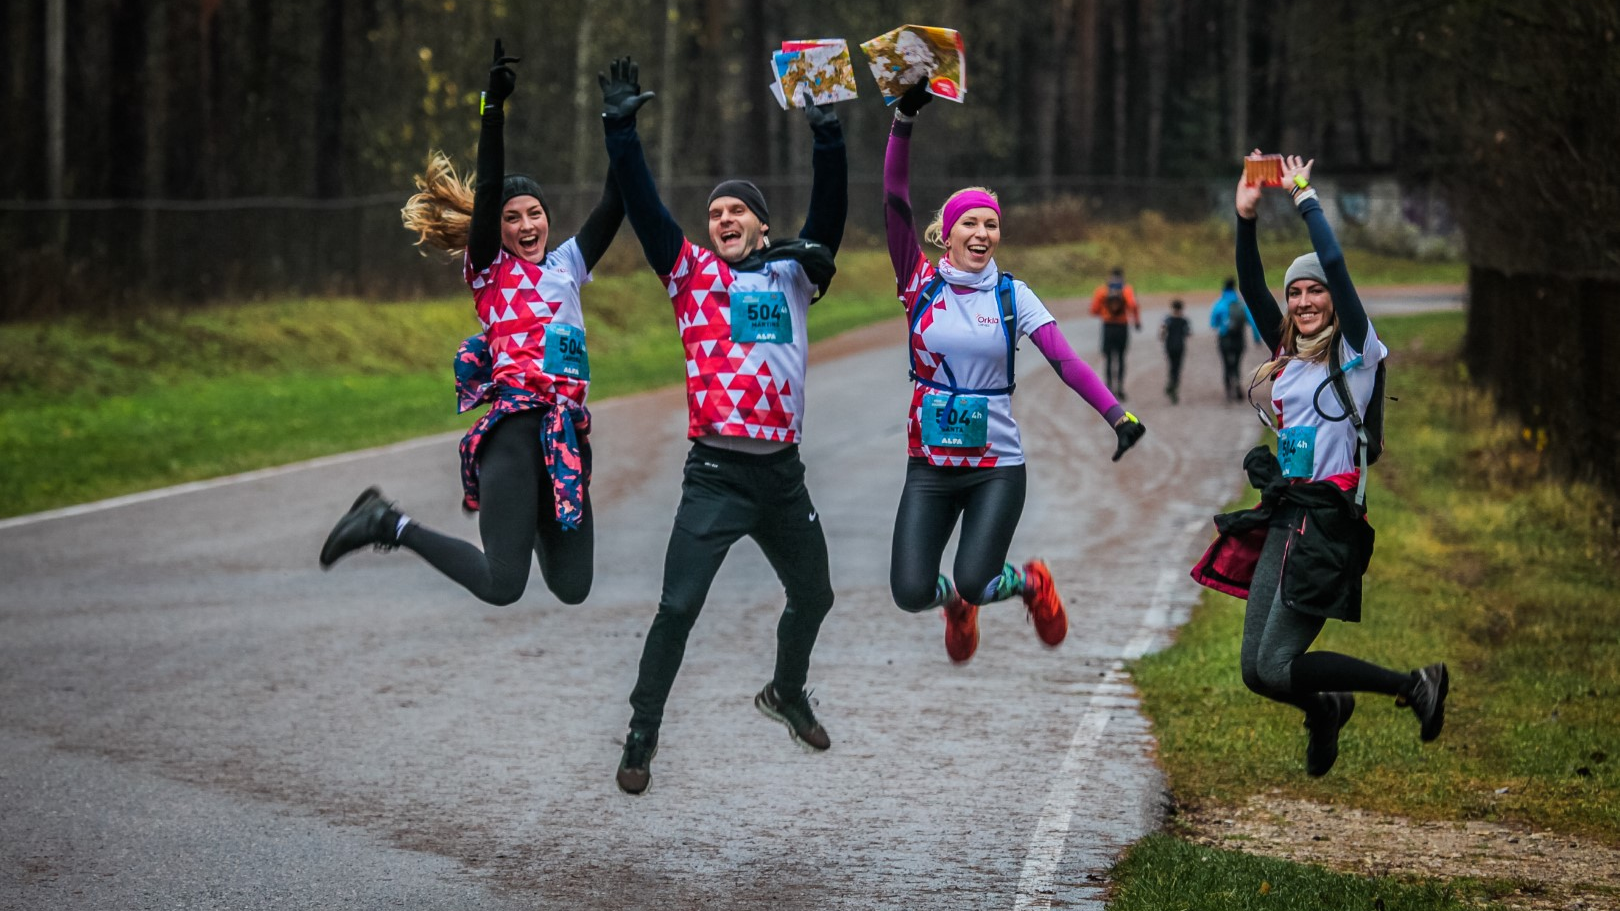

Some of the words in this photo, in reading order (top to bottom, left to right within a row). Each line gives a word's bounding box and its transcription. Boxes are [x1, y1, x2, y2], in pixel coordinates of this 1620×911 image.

[747, 304, 781, 321] 504
[977, 316, 999, 324] Orkla
[559, 336, 583, 357] 504
[935, 408, 971, 427] 504
[971, 411, 983, 419] 4h
[941, 437, 963, 445] ALFA
[1296, 440, 1308, 449] 4h
